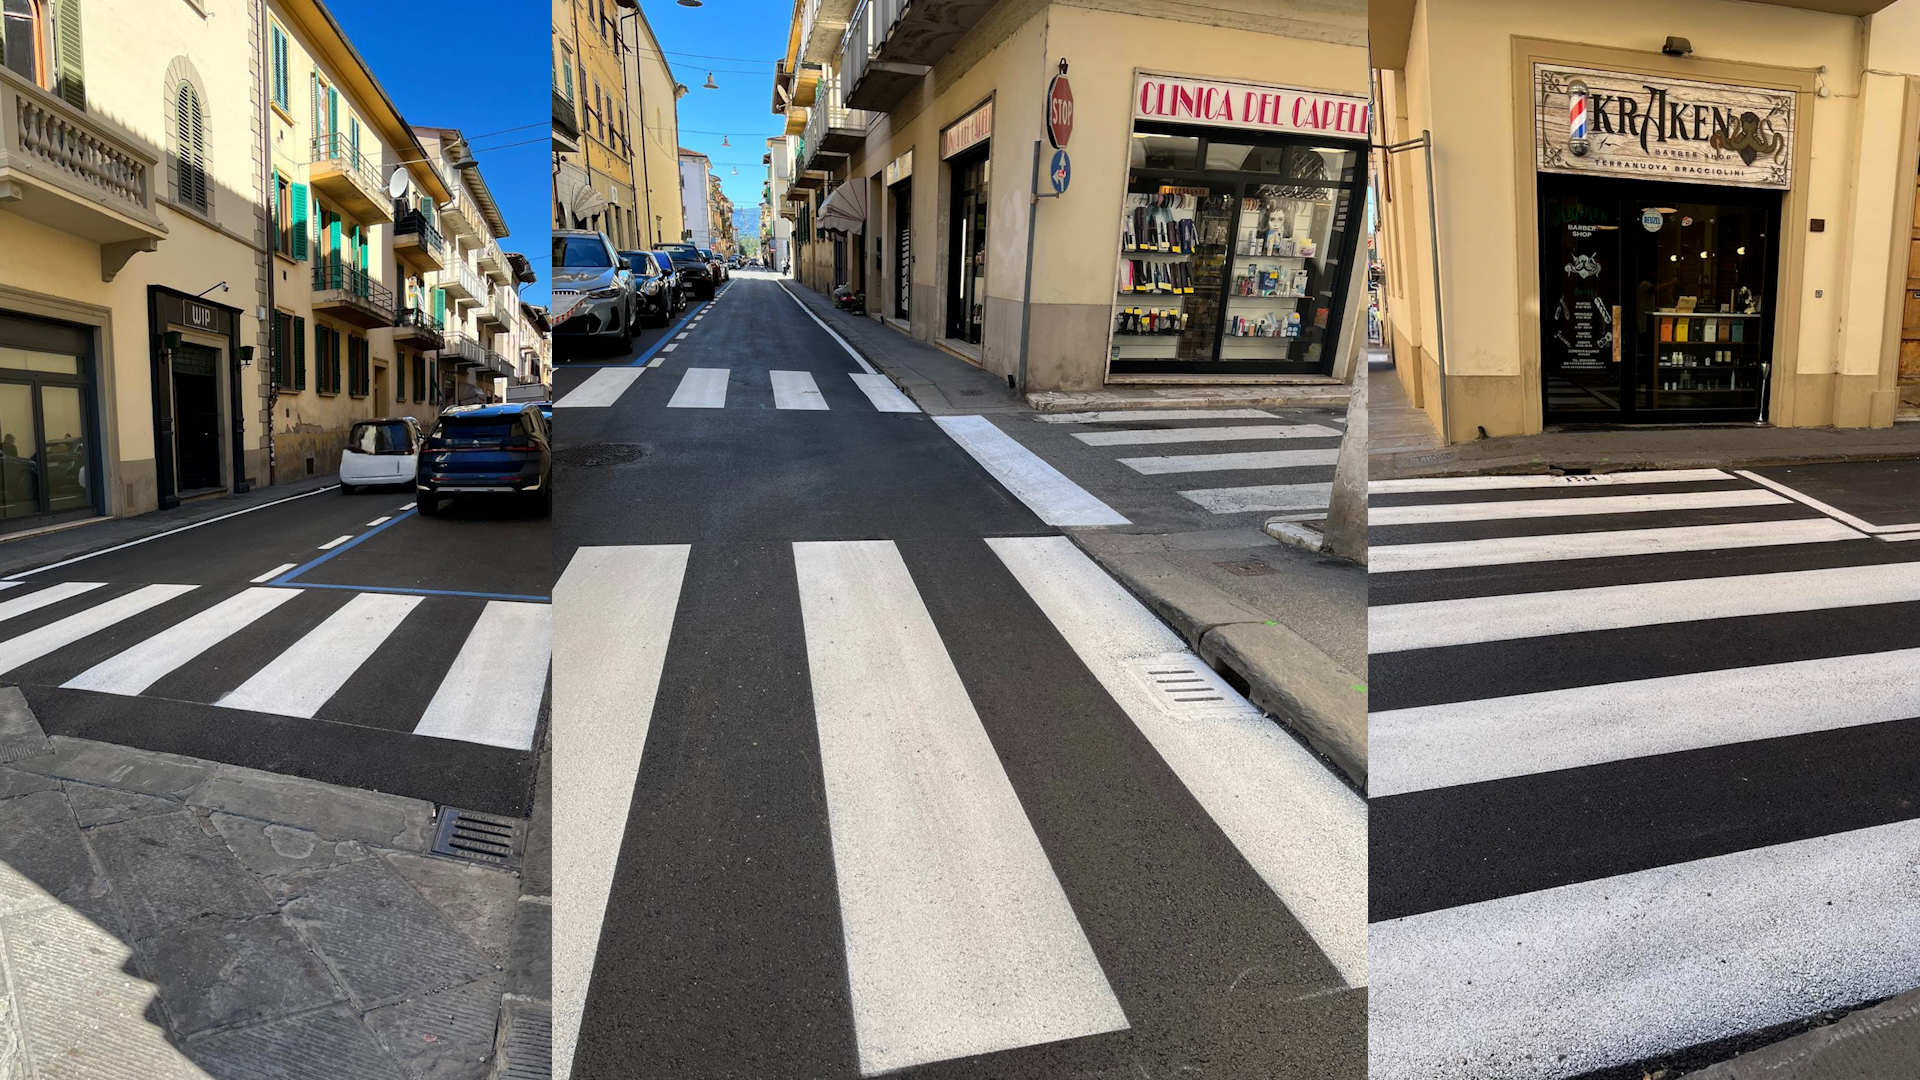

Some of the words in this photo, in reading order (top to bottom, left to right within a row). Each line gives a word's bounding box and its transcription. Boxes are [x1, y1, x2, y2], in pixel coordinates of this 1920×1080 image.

[1052, 97, 1073, 126] STOP
[1139, 81, 1234, 121] CLINICA
[1242, 91, 1284, 126] DEL
[1591, 85, 1732, 155] KRAKEN
[1654, 148, 1698, 159] BARBER
[1594, 159, 1668, 171] TERRANUOVA
[1674, 165, 1745, 177] BRACCIOLINI
[1567, 224, 1596, 232] BARBER
[192, 305, 211, 327] WIP
